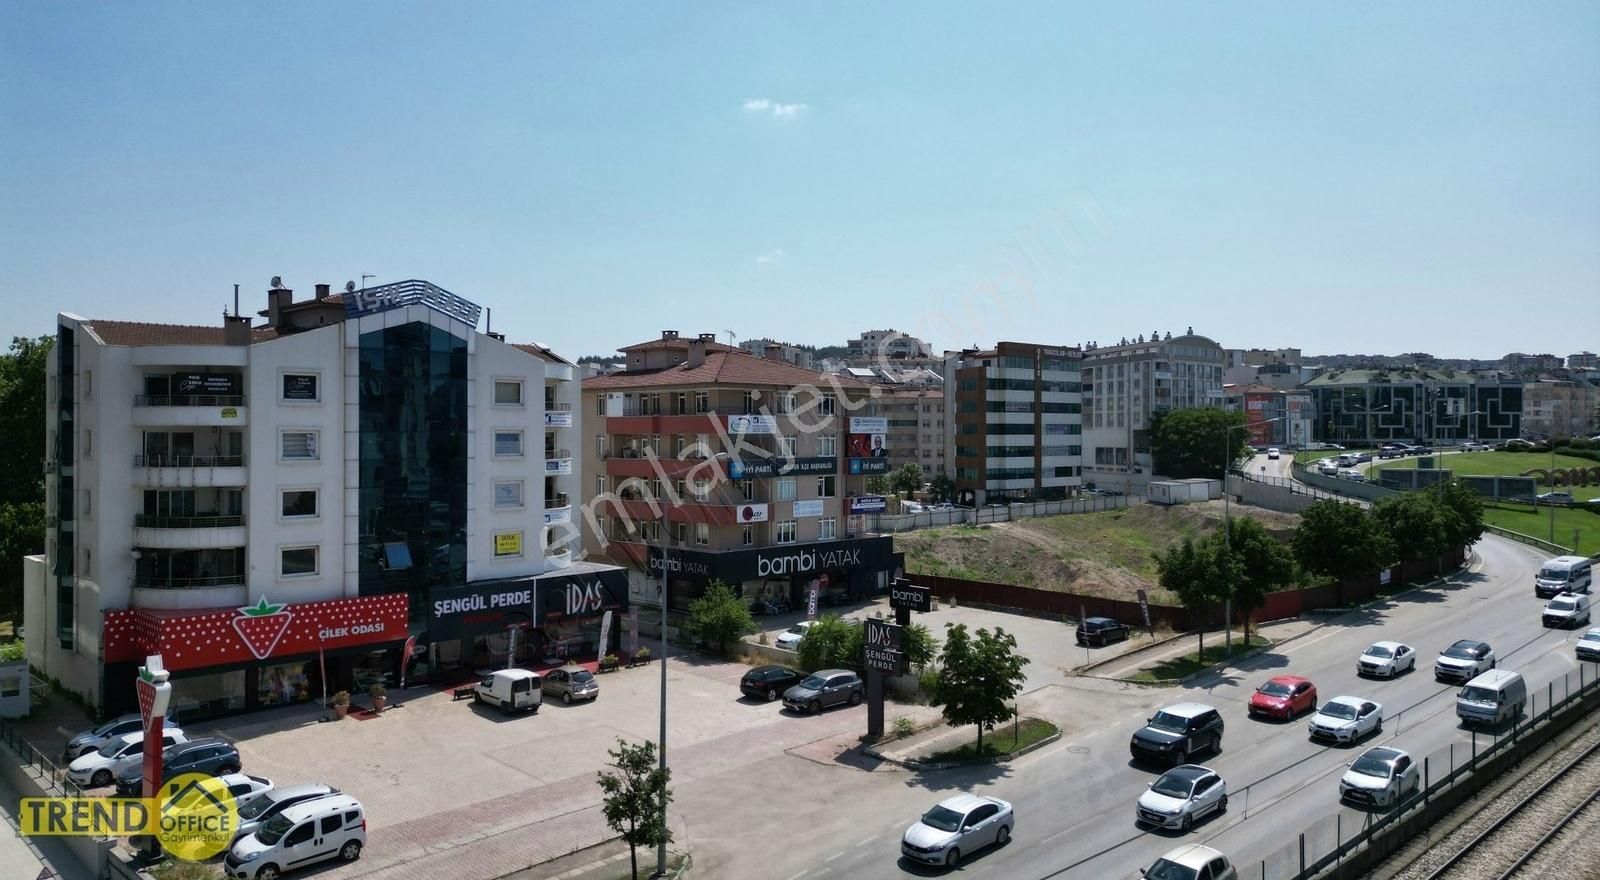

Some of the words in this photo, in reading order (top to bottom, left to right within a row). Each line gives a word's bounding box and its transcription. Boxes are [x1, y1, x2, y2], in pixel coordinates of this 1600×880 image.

[755, 464, 772, 473] PARTİ
[870, 461, 884, 471] PARTİ
[650, 555, 682, 572] bambi
[683, 561, 709, 576] YATAK
[758, 549, 816, 577] bambi
[818, 548, 861, 569] YATAK
[808, 589, 817, 615] bambi
[892, 587, 924, 603] bambi
[434, 592, 488, 618] ŞENGÜL
[490, 590, 532, 608] PERDE
[241, 616, 285, 629] ÇİLEK
[318, 625, 349, 641] ÇİLEK
[351, 622, 385, 636] ODASI
[865, 649, 897, 663] ŞENGÜL
[868, 659, 894, 671] PERDE
